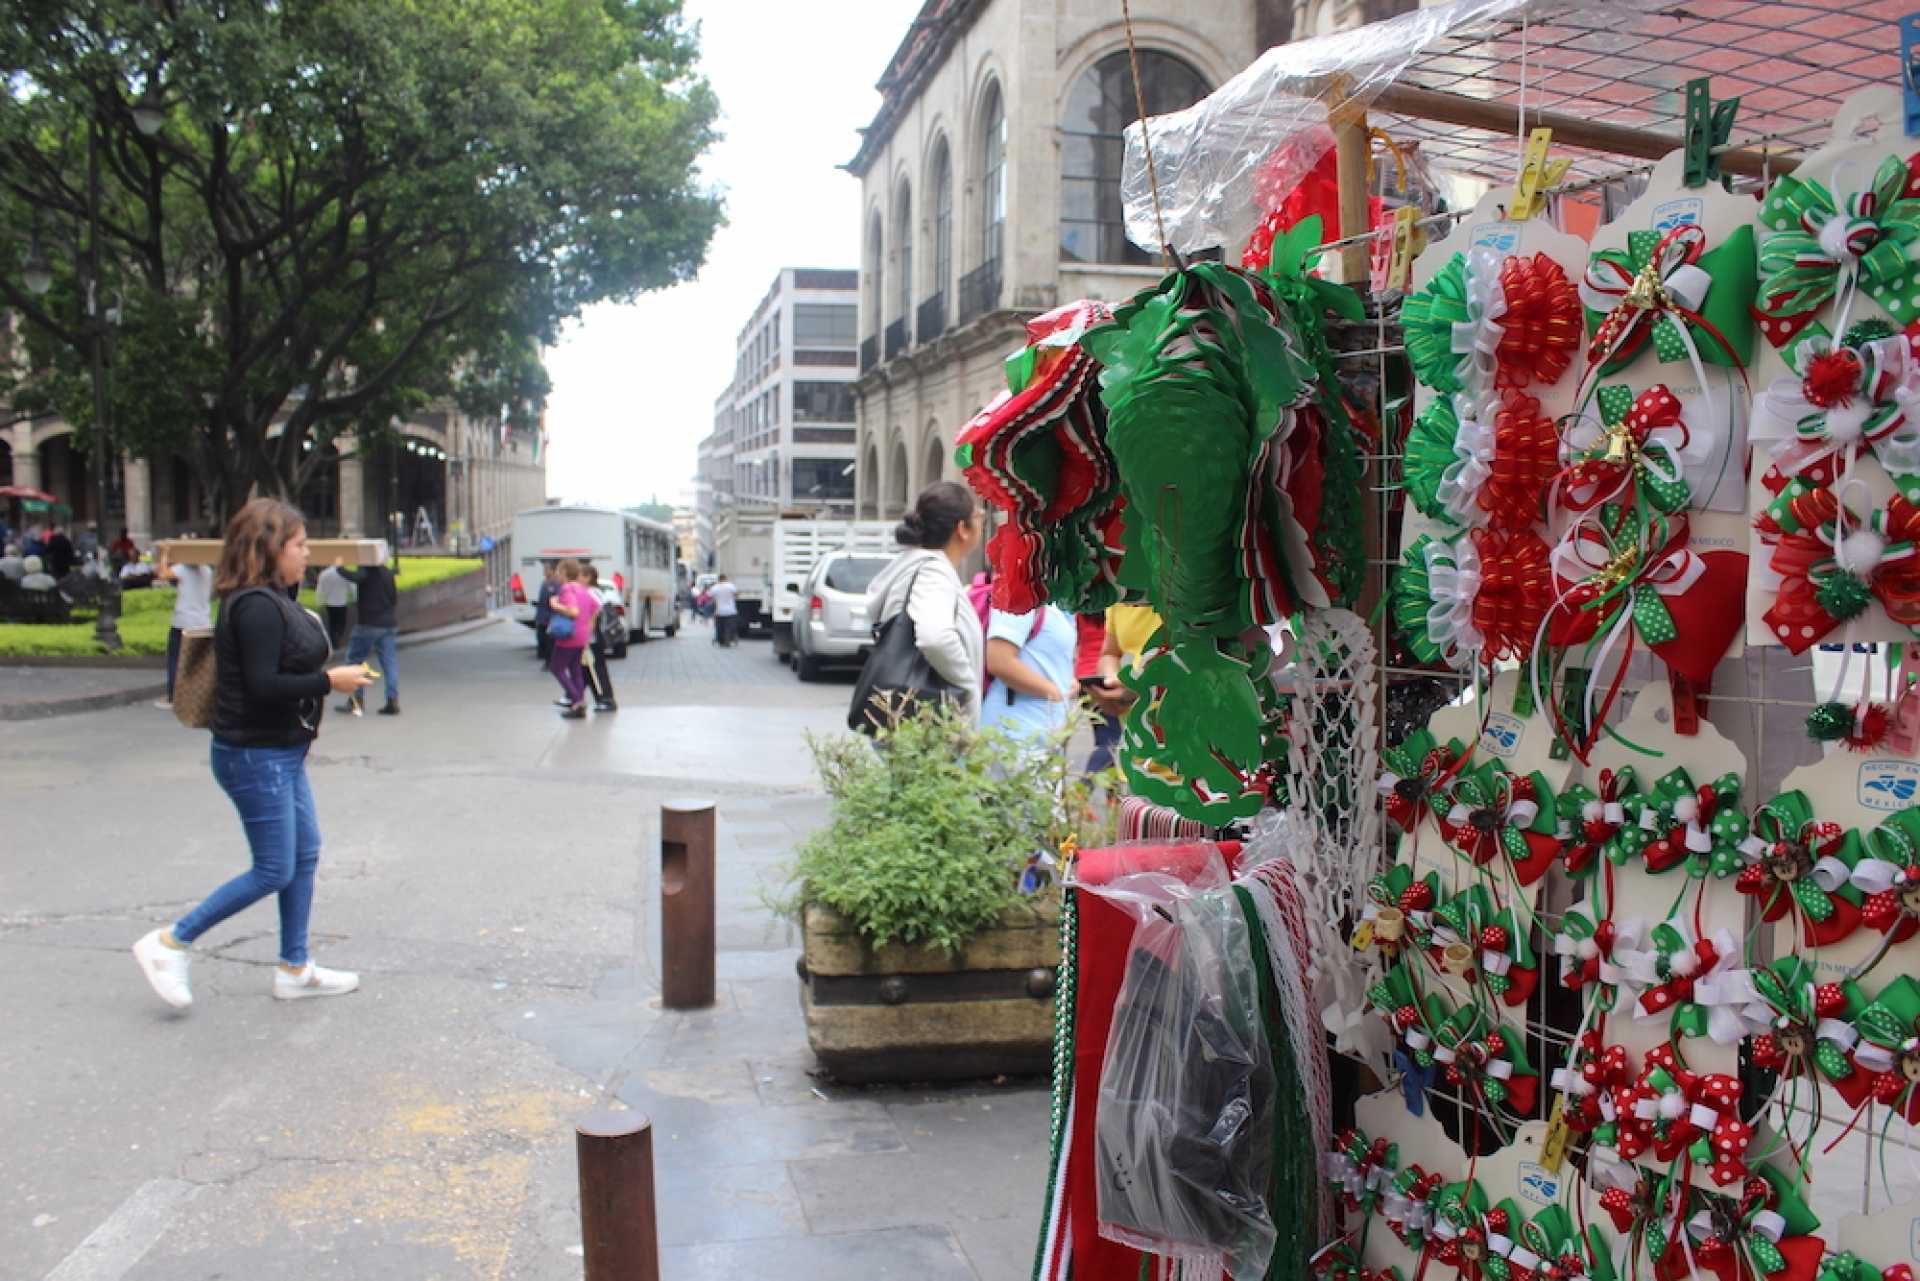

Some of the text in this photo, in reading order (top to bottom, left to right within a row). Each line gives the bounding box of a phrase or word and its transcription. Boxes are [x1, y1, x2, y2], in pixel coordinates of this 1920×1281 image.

[1698, 537, 1735, 548] MEXICO
[1864, 763, 1919, 775] HECHO EN
[1864, 796, 1916, 808] MEXICO
